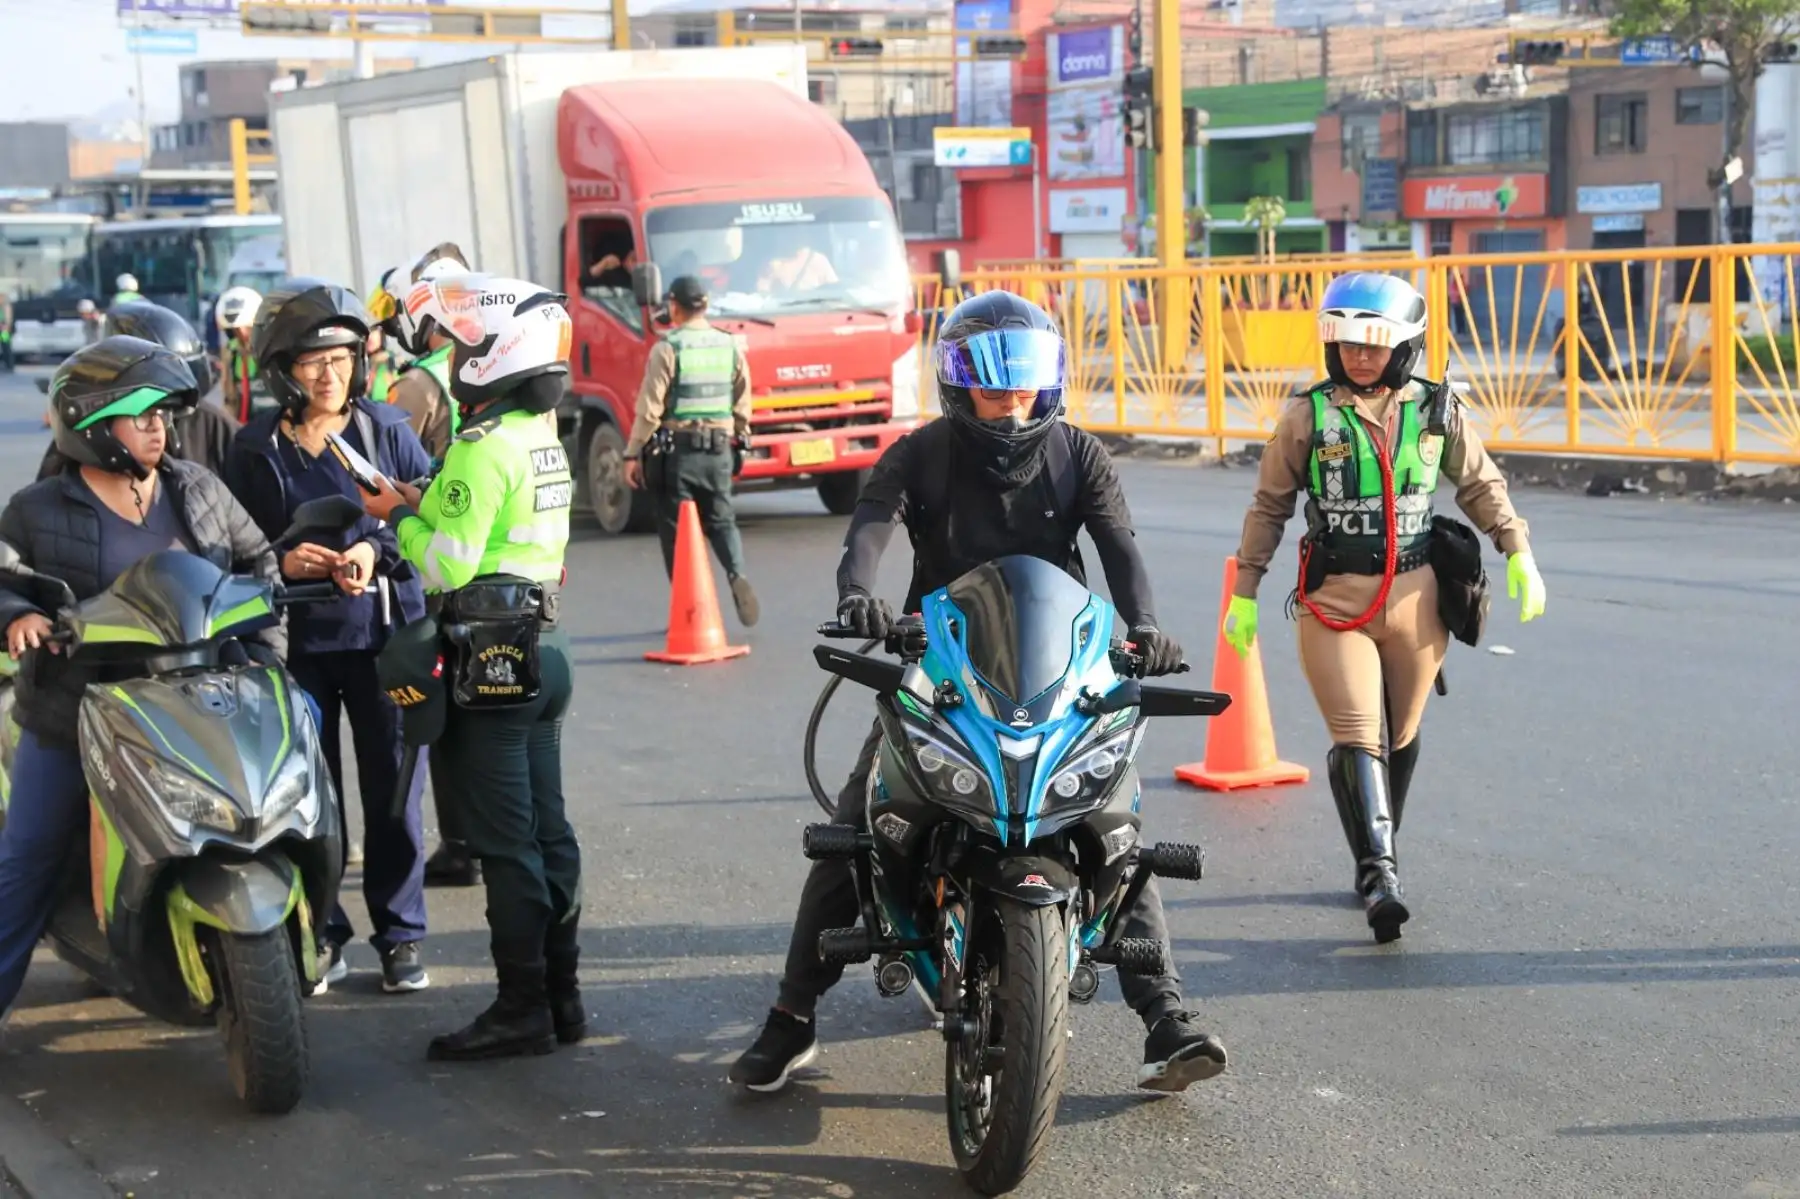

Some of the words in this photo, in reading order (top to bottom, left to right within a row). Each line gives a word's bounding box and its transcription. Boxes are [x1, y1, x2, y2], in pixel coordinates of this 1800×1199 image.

[1062, 51, 1105, 74] donna
[1425, 183, 1495, 212] Mifarma
[741, 201, 803, 217] ISUZU
[776, 364, 832, 381] ISUZU
[531, 447, 568, 475] POLICIA
[479, 644, 524, 662] POLICIA
[477, 685, 523, 694] TRANSITO
